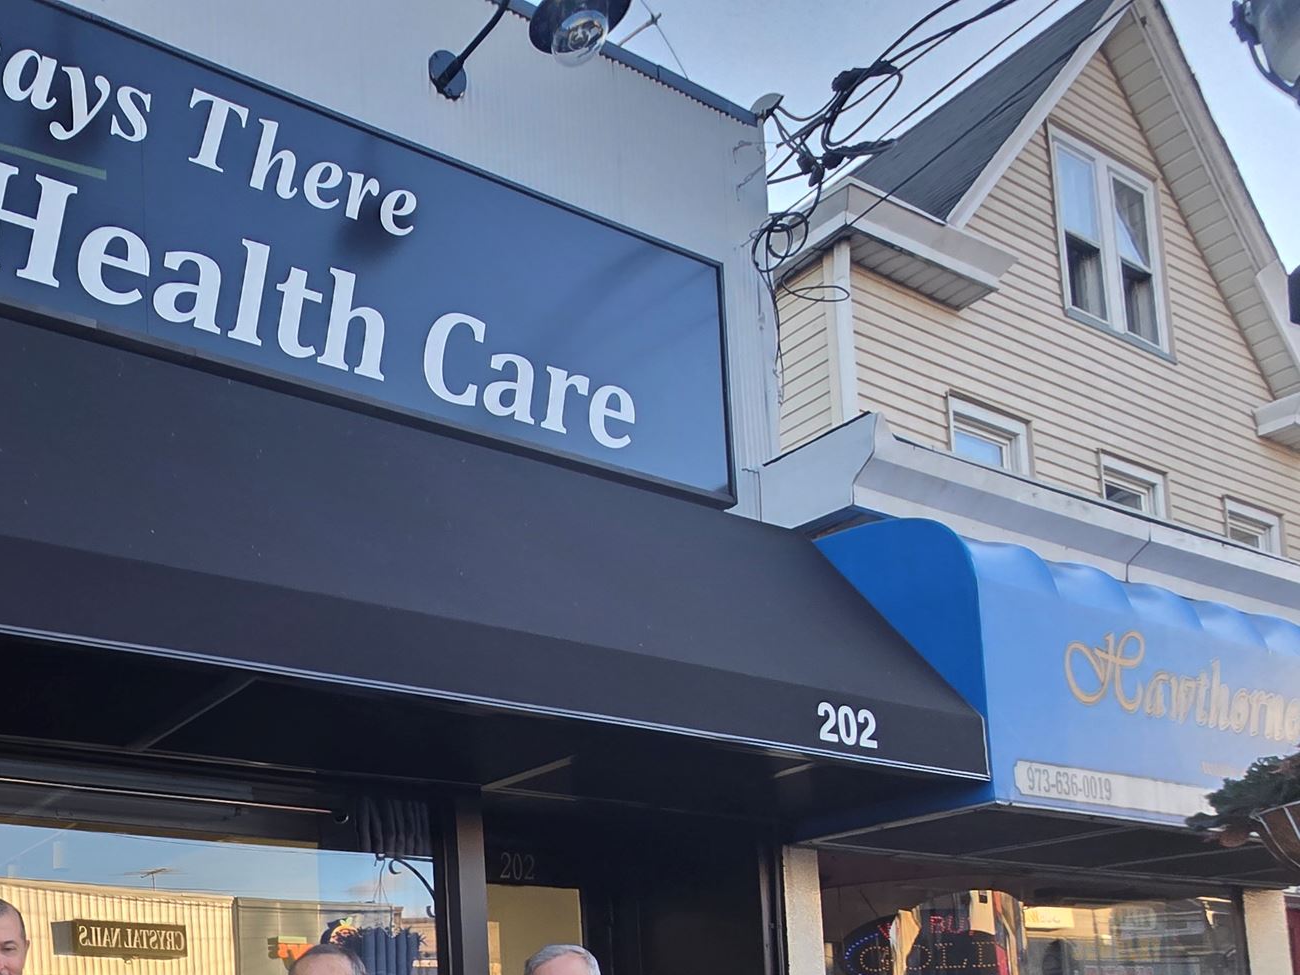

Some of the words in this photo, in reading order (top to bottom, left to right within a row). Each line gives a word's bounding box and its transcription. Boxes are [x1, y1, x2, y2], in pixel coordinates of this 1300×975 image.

[187, 87, 417, 237] There
[423, 312, 636, 449] Care
[816, 701, 879, 749] 202
[1026, 766, 1112, 800] 973-636-0019
[500, 851, 535, 880] 202
[930, 916, 973, 936] BU
